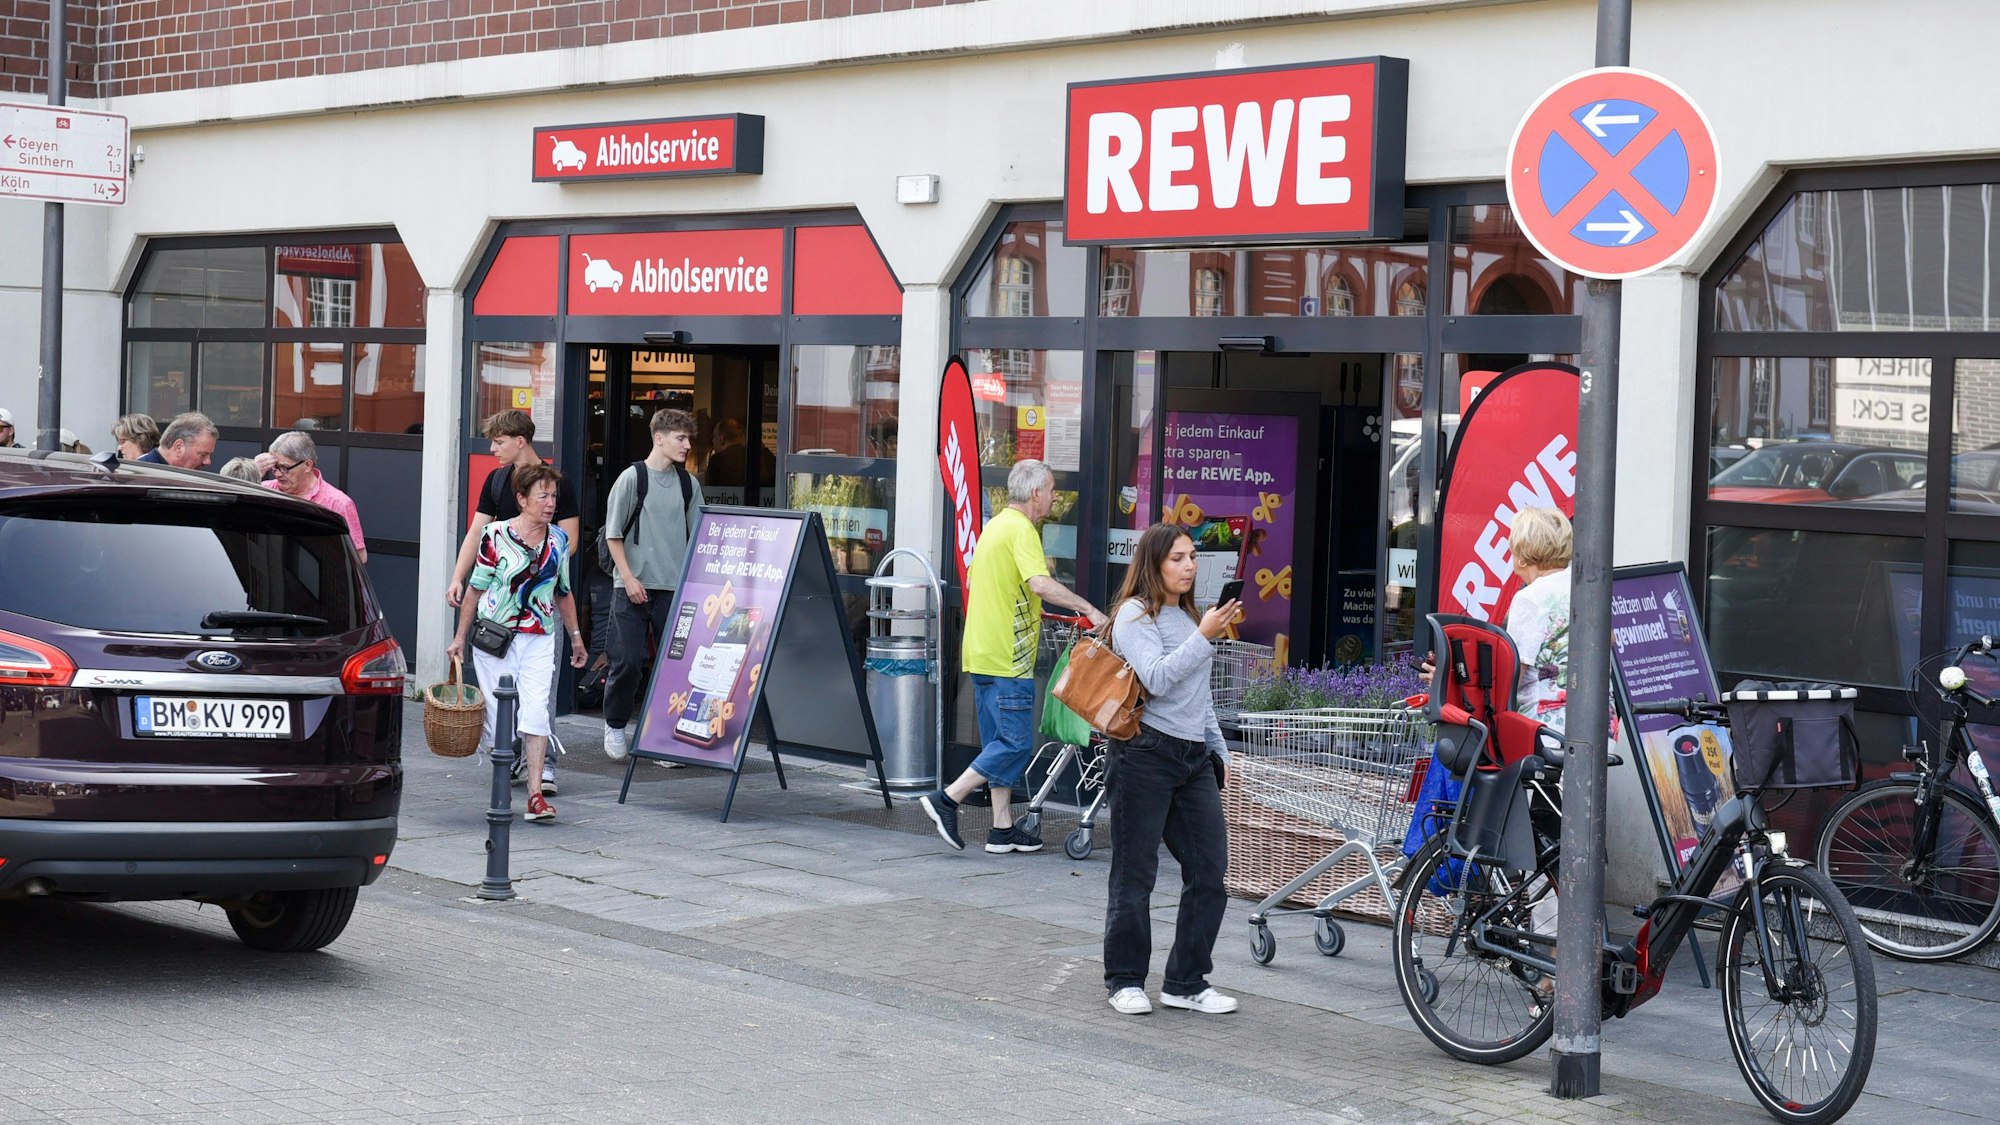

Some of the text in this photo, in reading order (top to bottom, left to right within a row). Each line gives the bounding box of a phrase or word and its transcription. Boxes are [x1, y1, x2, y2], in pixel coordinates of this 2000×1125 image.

[19, 137, 122, 157] Geyen 2,7
[596, 129, 720, 167] Abholservice
[1086, 94, 1351, 214] REWE
[19, 153, 122, 173] Sinthern 1,3
[0, 176, 105, 195] Köln 14
[630, 256, 769, 293] Abholservice
[1581, 371, 1592, 394] 3
[1164, 424, 1265, 440] ei jedem Einkauf
[1163, 446, 1184, 459] tra
[1188, 448, 1230, 462] sparen
[1163, 465, 1275, 485] it der REWE App.
[705, 492, 740, 507] erzlich
[708, 521, 780, 542] Bei jedem Einkauf
[824, 517, 860, 532] ommen
[1451, 434, 1577, 622] REWE
[697, 542, 719, 555] extra
[720, 544, 747, 559] sparen
[1108, 538, 1138, 556] erzlic
[705, 559, 784, 582] mit der REWE App.
[1397, 559, 1416, 579] wi
[1343, 588, 1356, 598] Zu
[1611, 590, 1658, 616] chätzen und
[1342, 616, 1361, 624] was
[1613, 613, 1669, 654] gewinnen!
[207, 653, 233, 667] Ford
[141, 716, 147, 725] D
[153, 701, 285, 729] BM KV 999
[1680, 845, 1697, 863] REW
